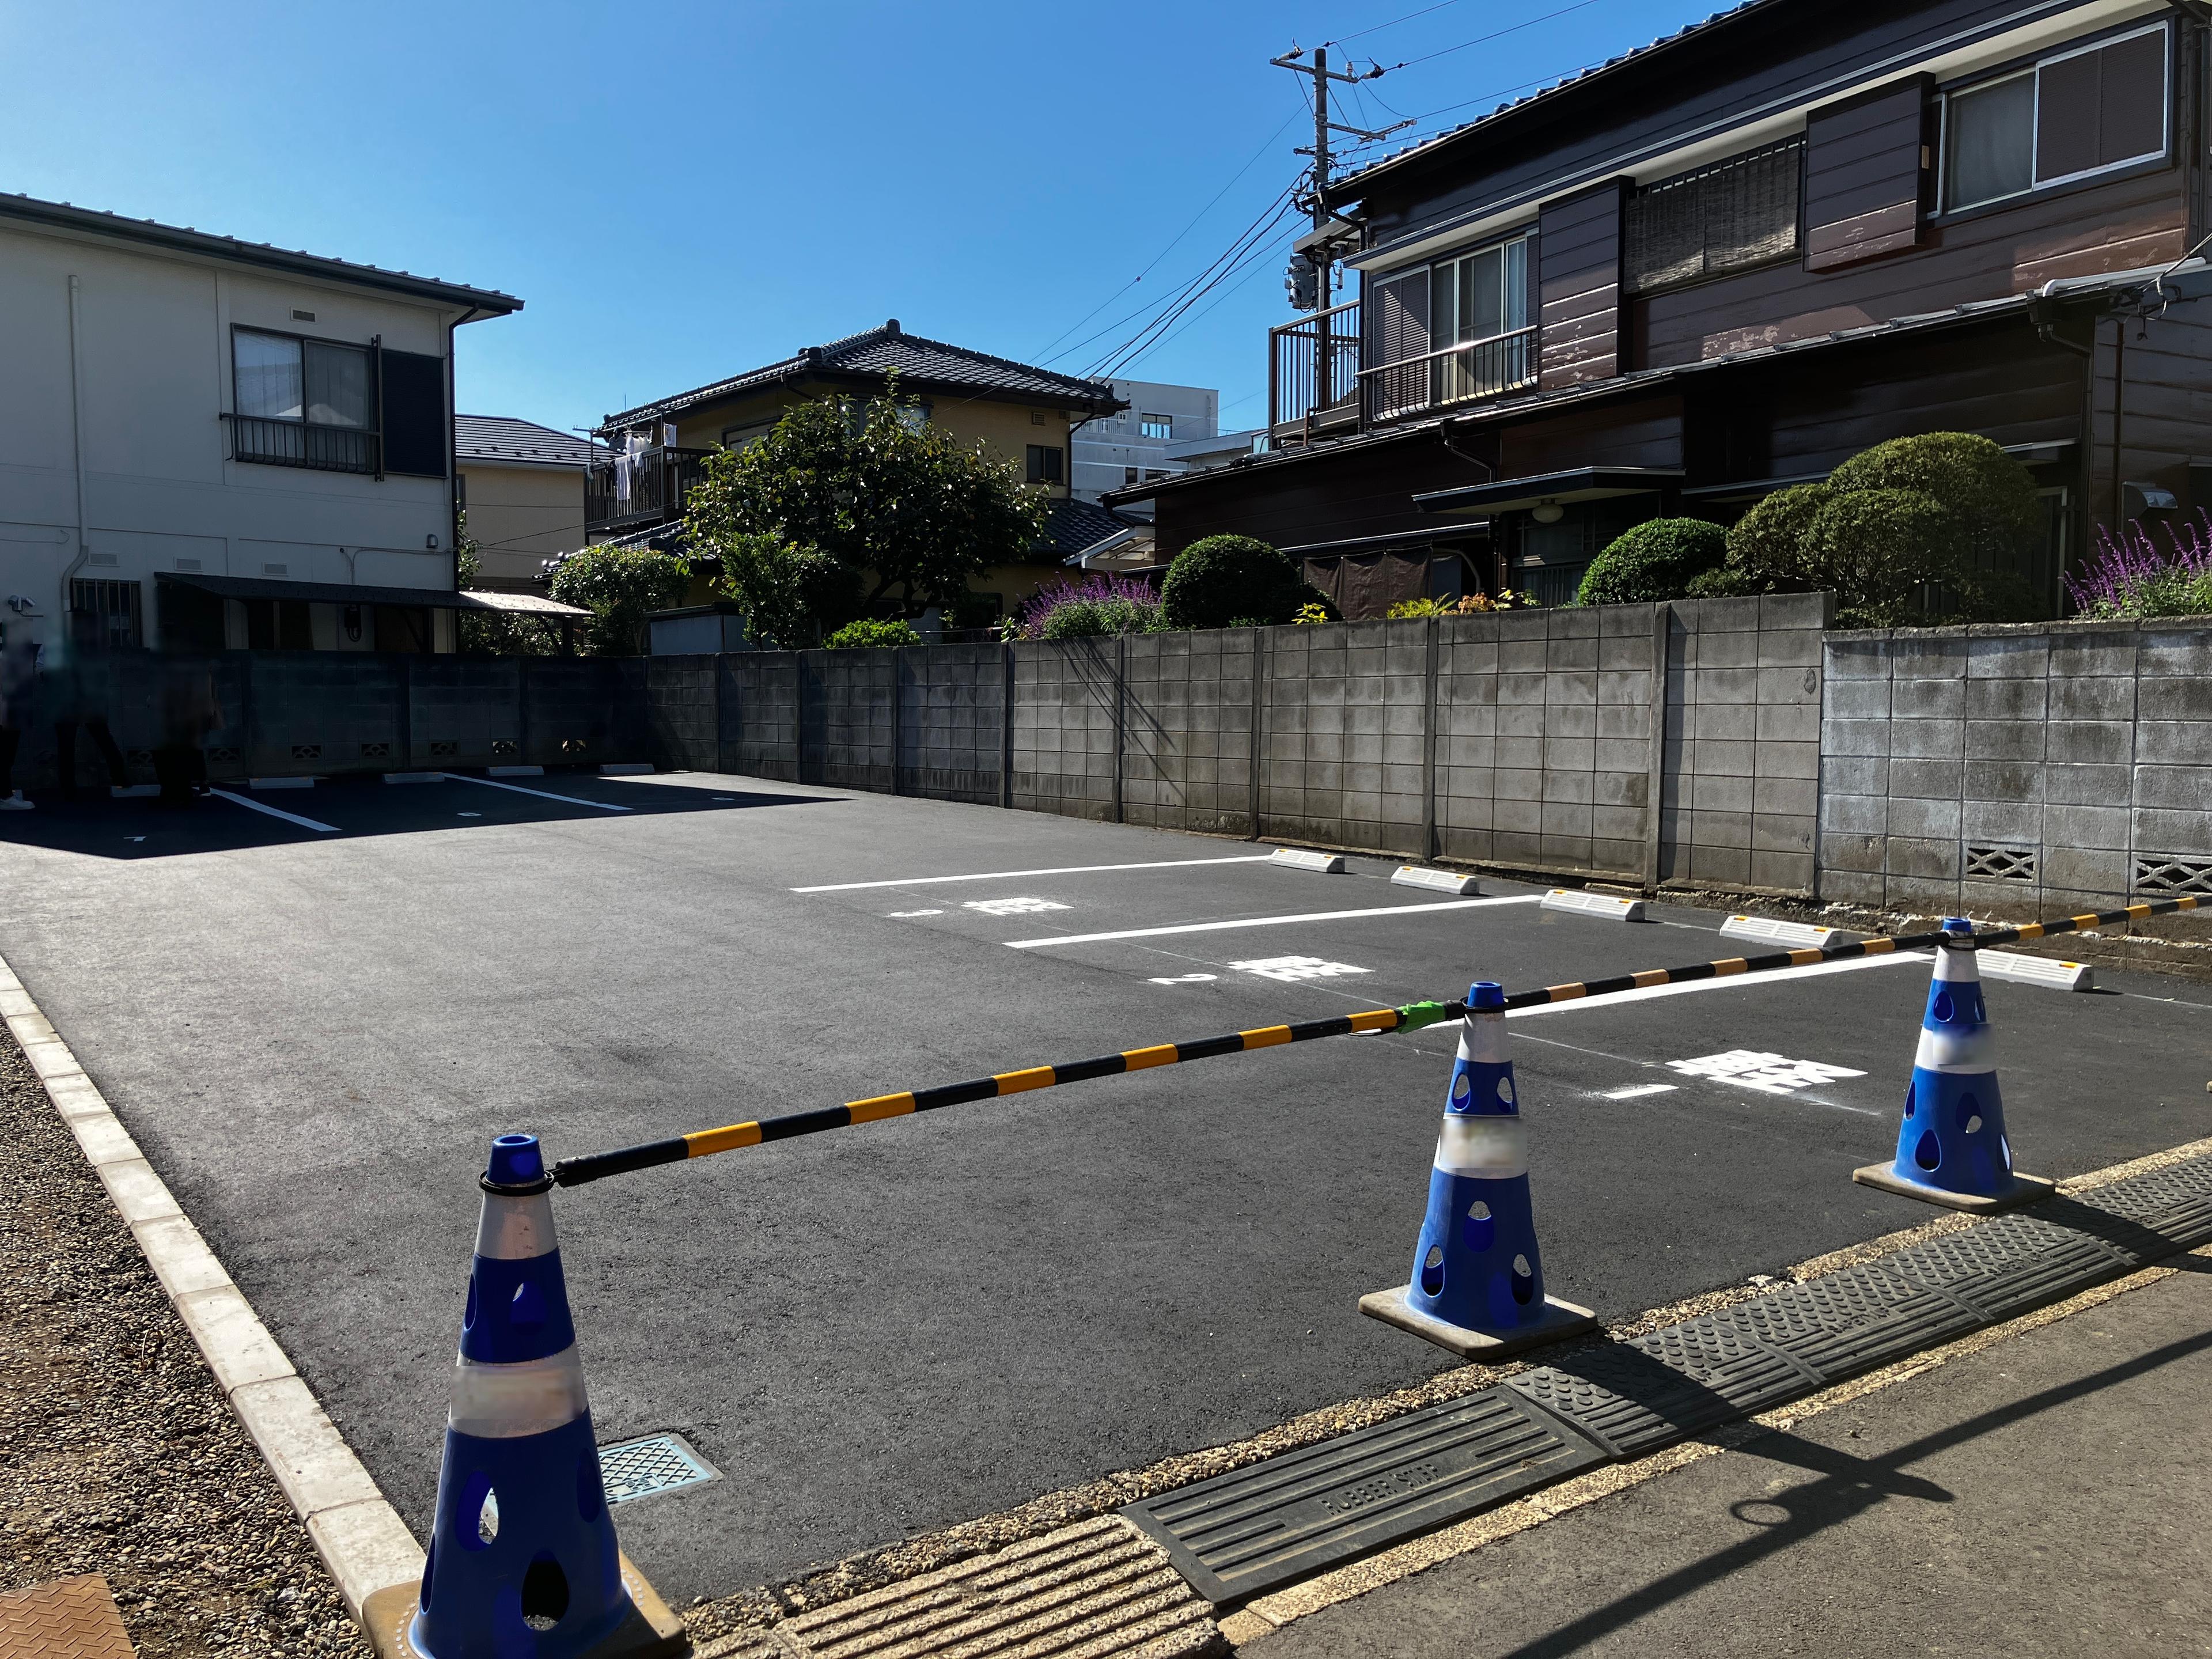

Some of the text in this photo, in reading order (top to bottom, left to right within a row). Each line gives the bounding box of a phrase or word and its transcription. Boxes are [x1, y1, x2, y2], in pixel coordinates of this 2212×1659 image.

[890, 909, 944, 918] 3
[1147, 973, 1218, 986] 2
[1227, 956, 1376, 982] 軽
[1665, 1049, 1868, 1094] 軽
[1601, 1084, 1680, 1100] 1
[1317, 1463, 1439, 1516] RUBBER STEP
